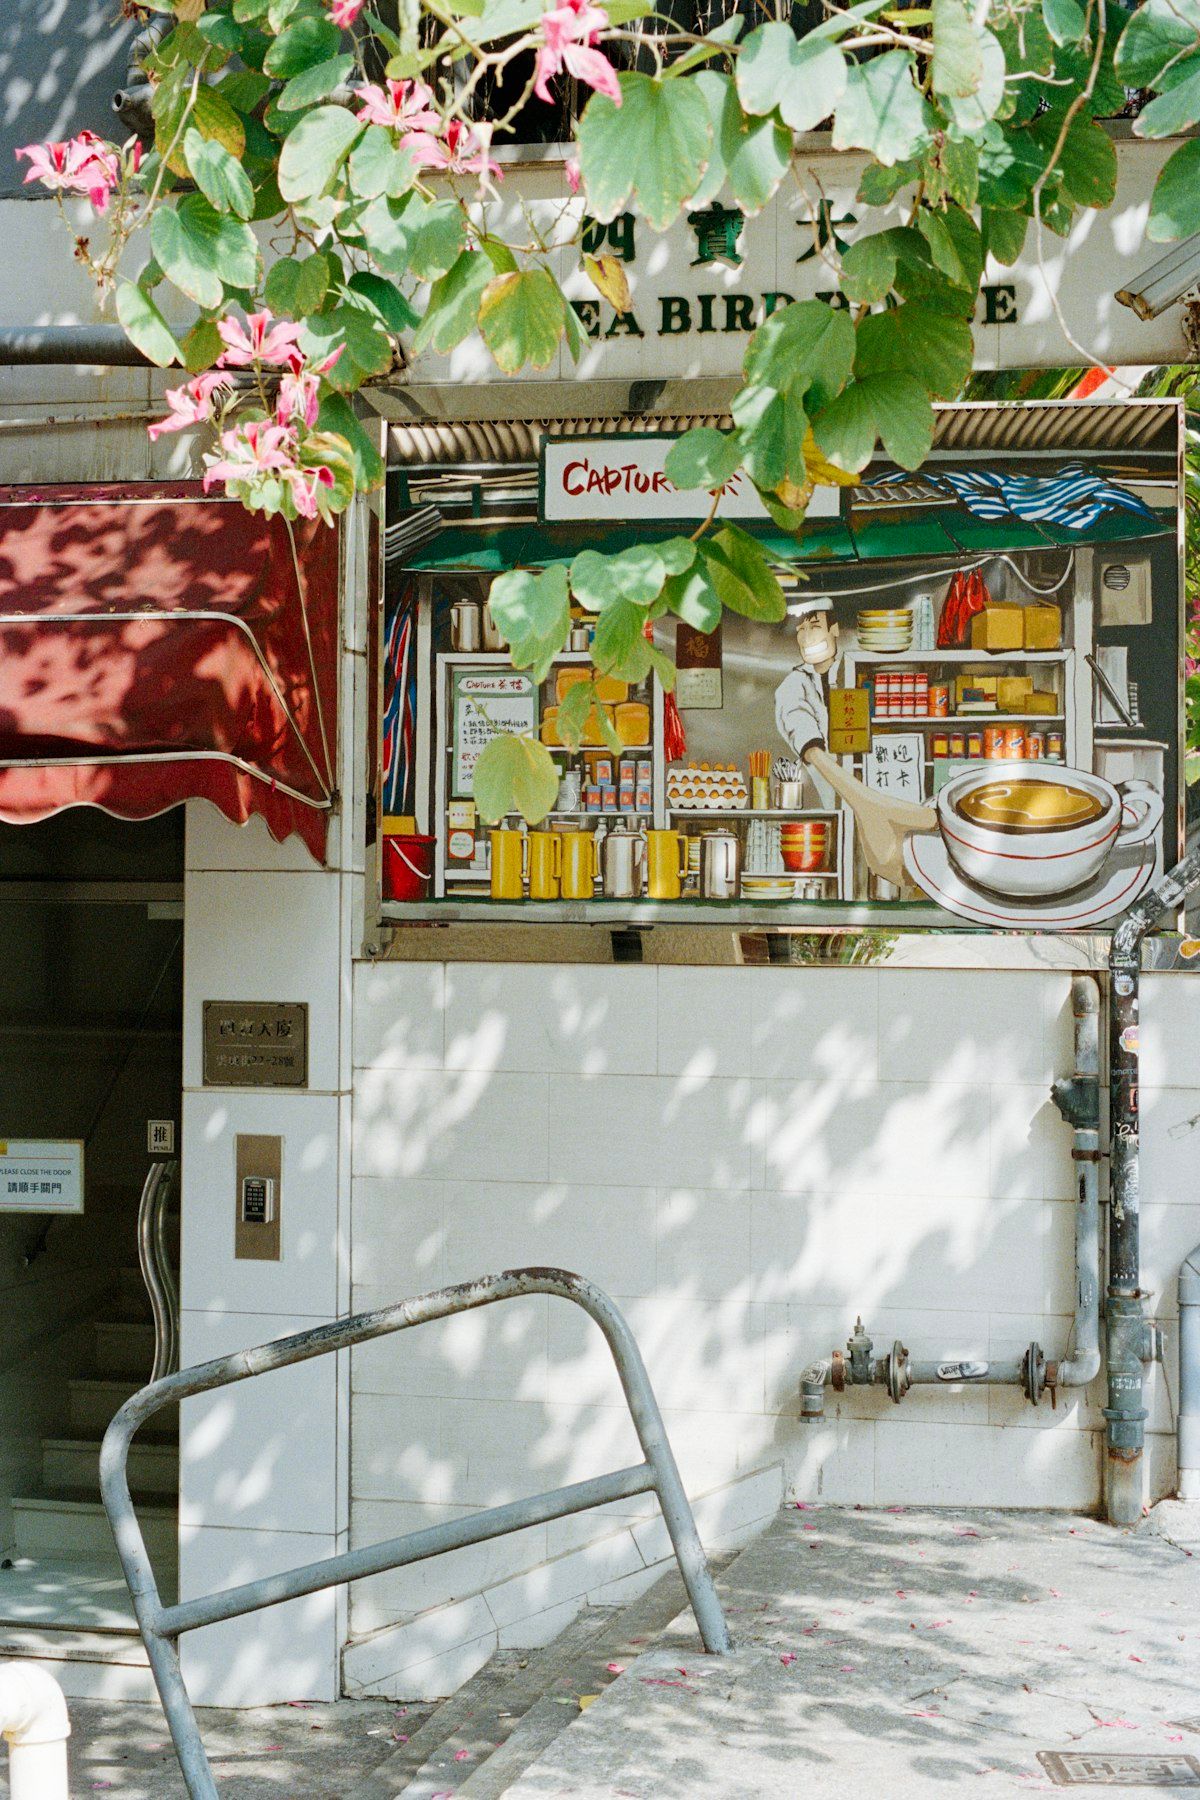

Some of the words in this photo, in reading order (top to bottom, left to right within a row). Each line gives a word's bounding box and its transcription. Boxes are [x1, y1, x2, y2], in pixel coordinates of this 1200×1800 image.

[562, 457, 679, 497] CAPTUR
[875, 768, 911, 788] 打卡
[153, 1126, 168, 1142] 推
[19, 1168, 39, 1176] CLOSE
[40, 1168, 52, 1176] THE
[7, 1181, 62, 1194] 請順手關門
